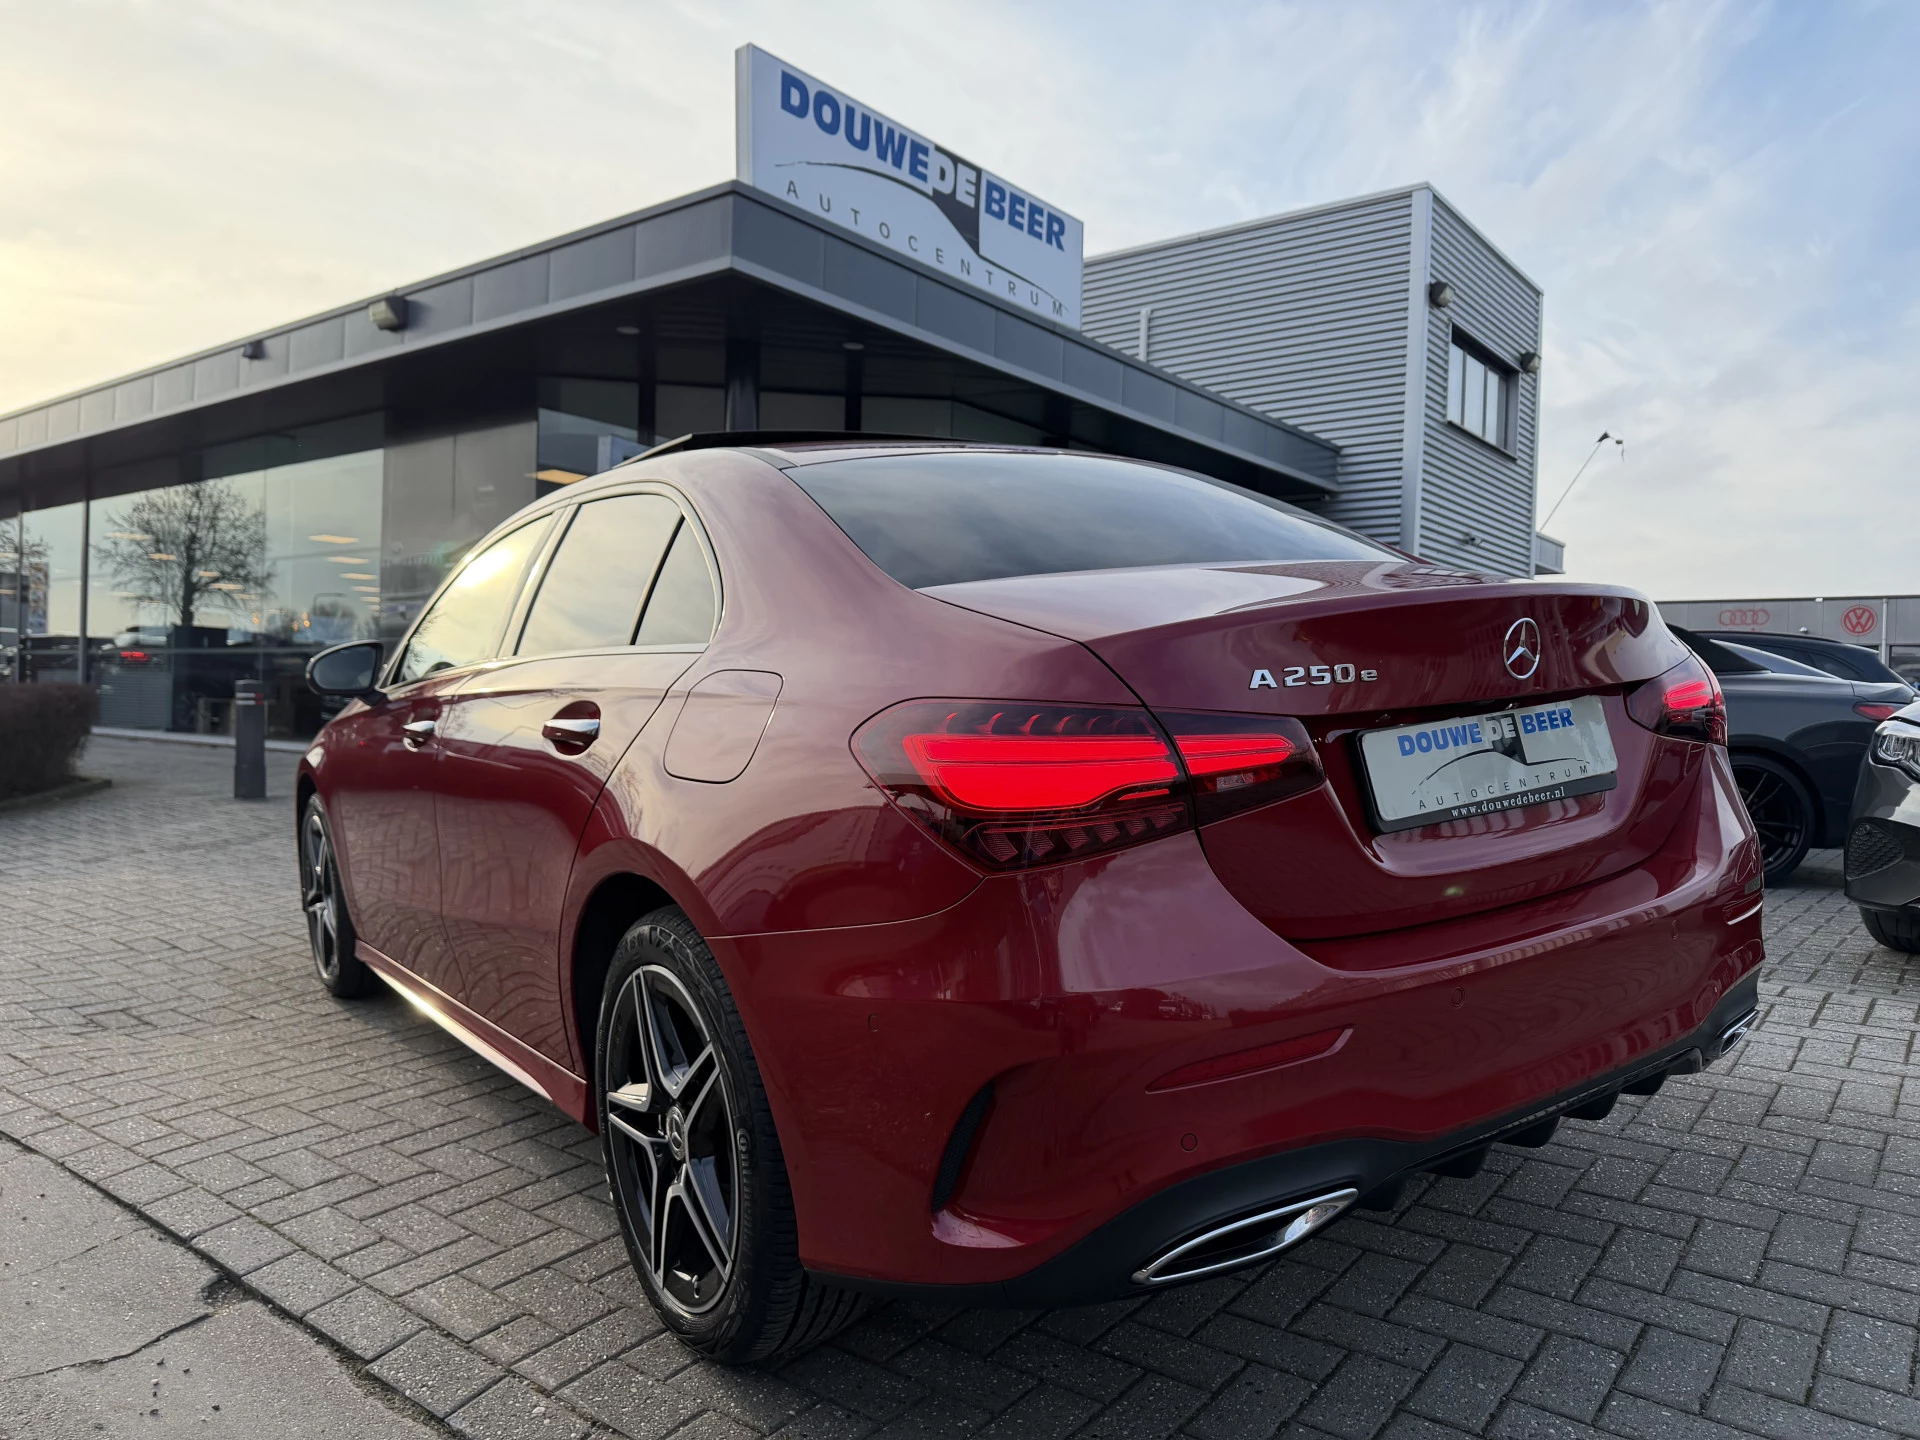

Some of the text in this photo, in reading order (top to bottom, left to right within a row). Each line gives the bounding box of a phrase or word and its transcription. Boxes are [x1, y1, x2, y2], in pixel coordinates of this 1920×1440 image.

[781, 70, 1066, 252] DOUWE DE BEER
[786, 180, 1063, 317] AUTOCENTRUM
[1397, 707, 1574, 757] DOUWE DE BEER
[1418, 764, 1588, 810] AUTOCENTRUM
[1451, 786, 1565, 818] www.douwedebeer.nl
